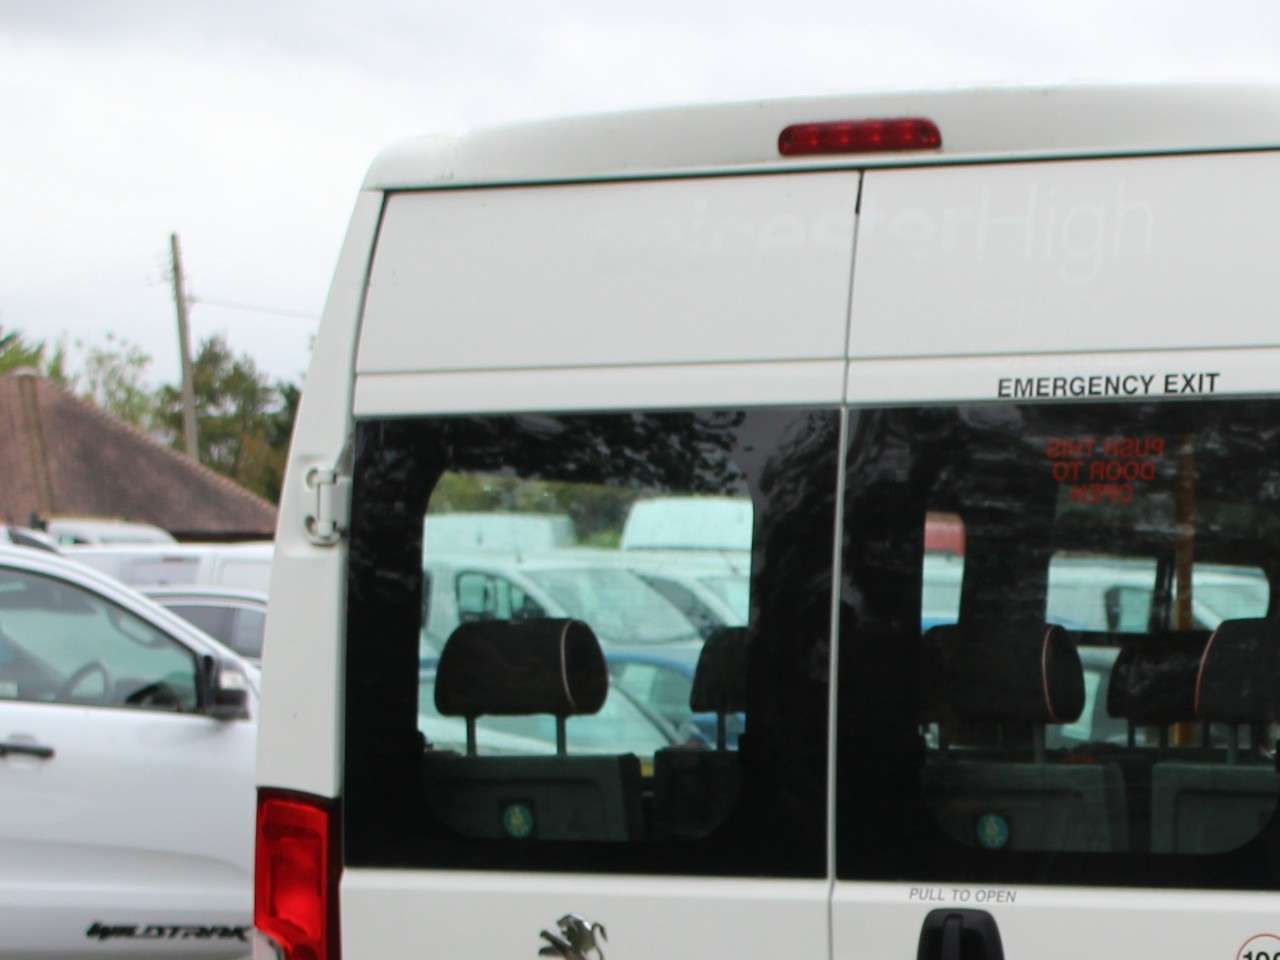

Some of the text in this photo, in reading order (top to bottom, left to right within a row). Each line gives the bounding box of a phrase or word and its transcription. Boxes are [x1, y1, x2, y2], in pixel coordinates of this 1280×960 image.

[998, 372, 1220, 398] EMERGENCY EXIT
[910, 887, 1017, 904] PULL TO OPEN
